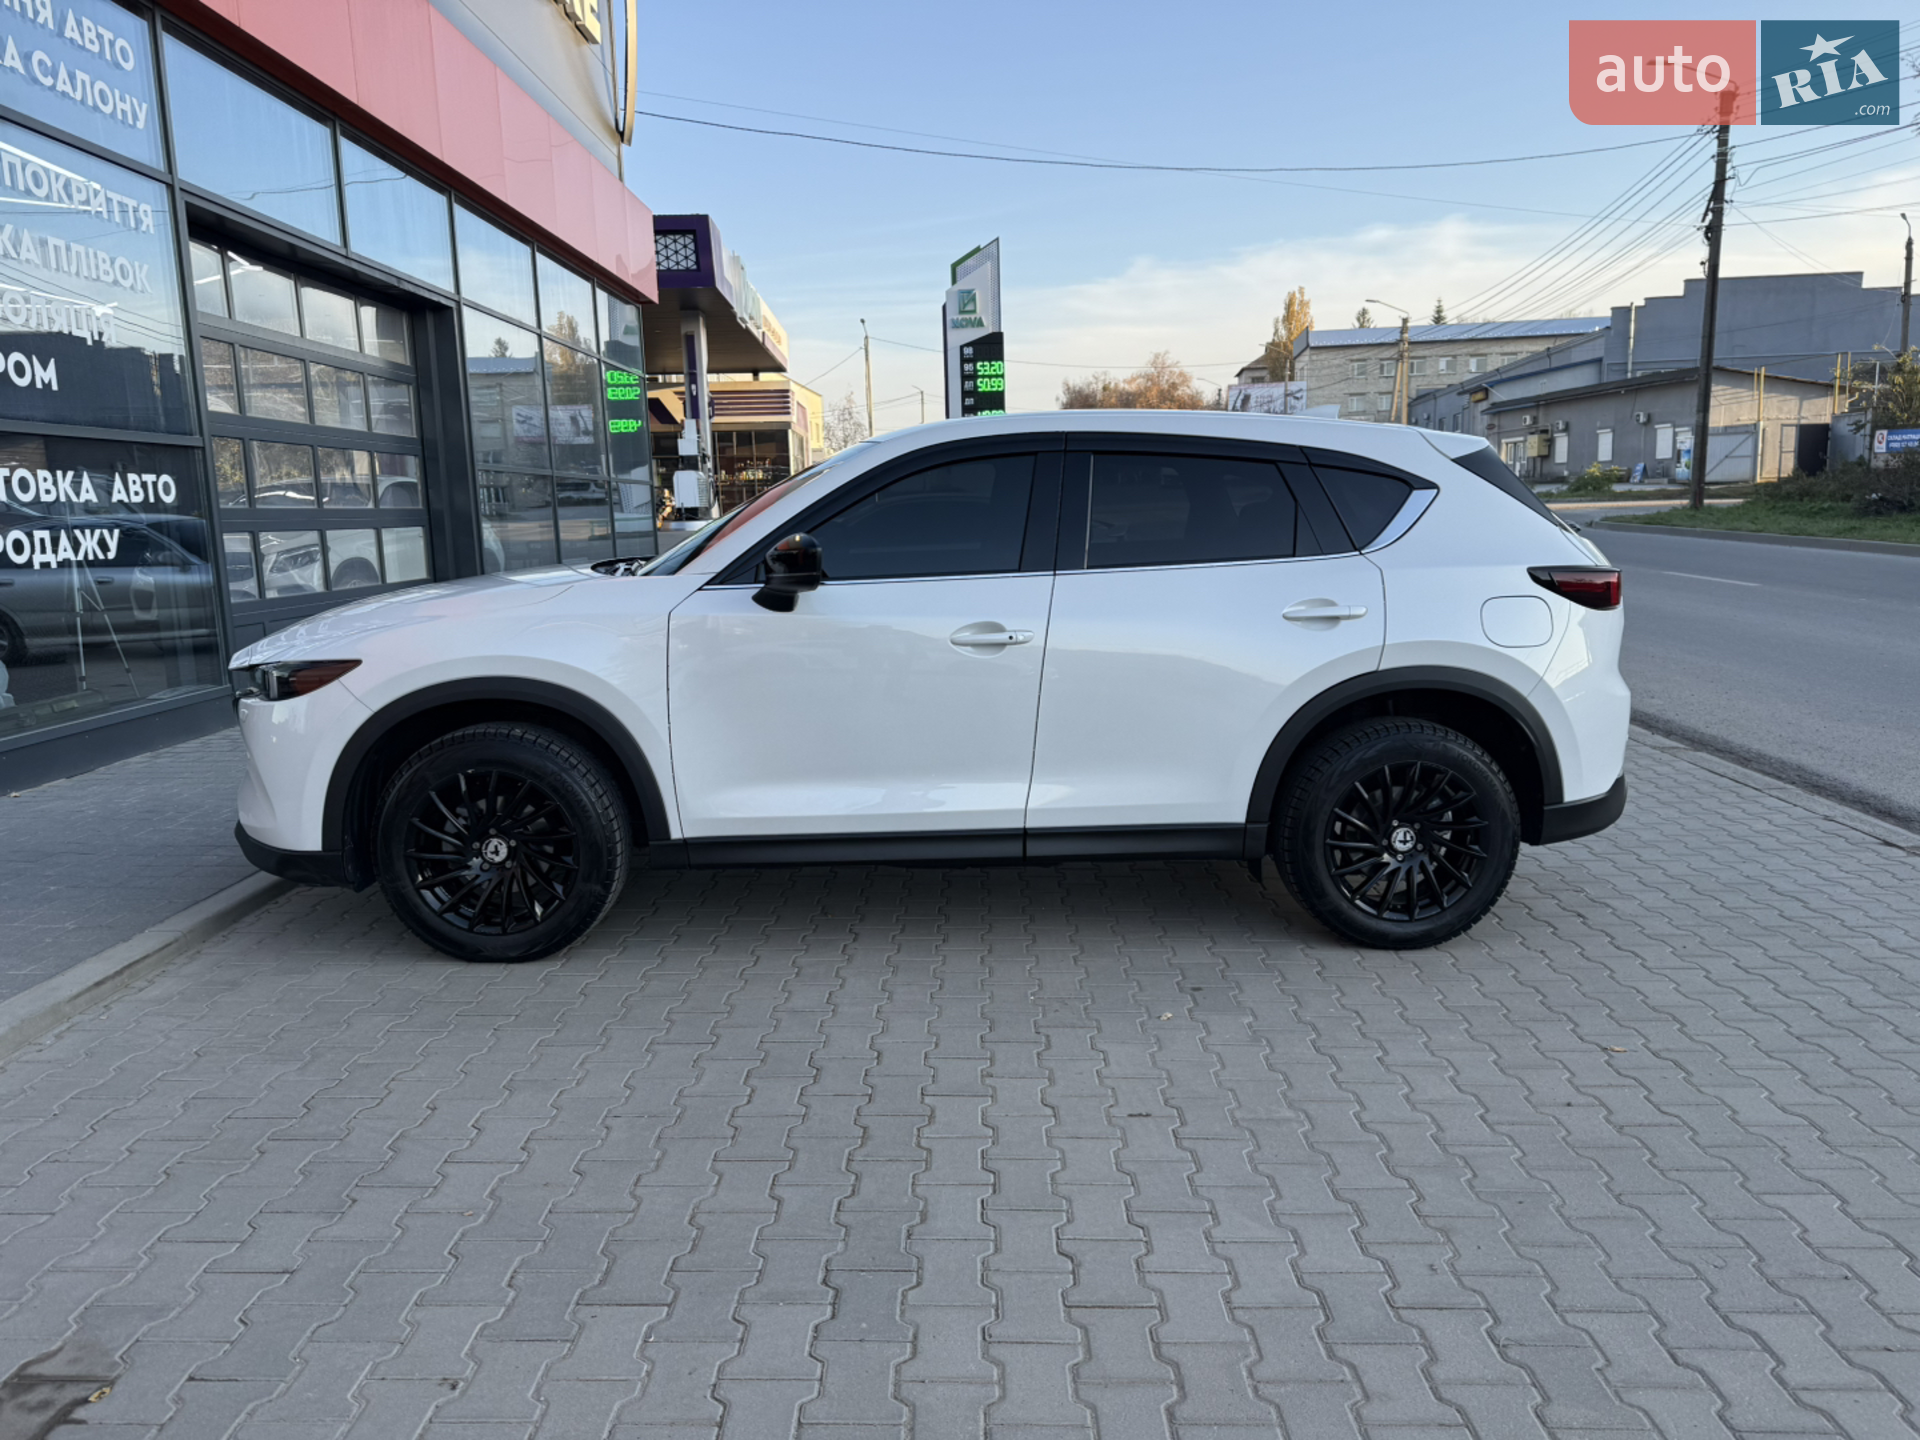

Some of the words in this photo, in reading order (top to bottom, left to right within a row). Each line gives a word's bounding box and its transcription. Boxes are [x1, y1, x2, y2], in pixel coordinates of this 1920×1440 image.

[64, 8, 135, 71] АВТО
[31, 50, 148, 129] САЛОНУ
[1, 154, 155, 234] ПОКРИТТЯ
[47, 235, 154, 294] ПЛІВОК
[0, 351, 59, 391] ОМ
[963, 363, 974, 372] 95
[976, 361, 1004, 375] 53.20
[111, 472, 176, 503] АВТО
[0, 529, 120, 570] ОДАЖУ
[549, 769, 593, 822] YOKOHAMA
